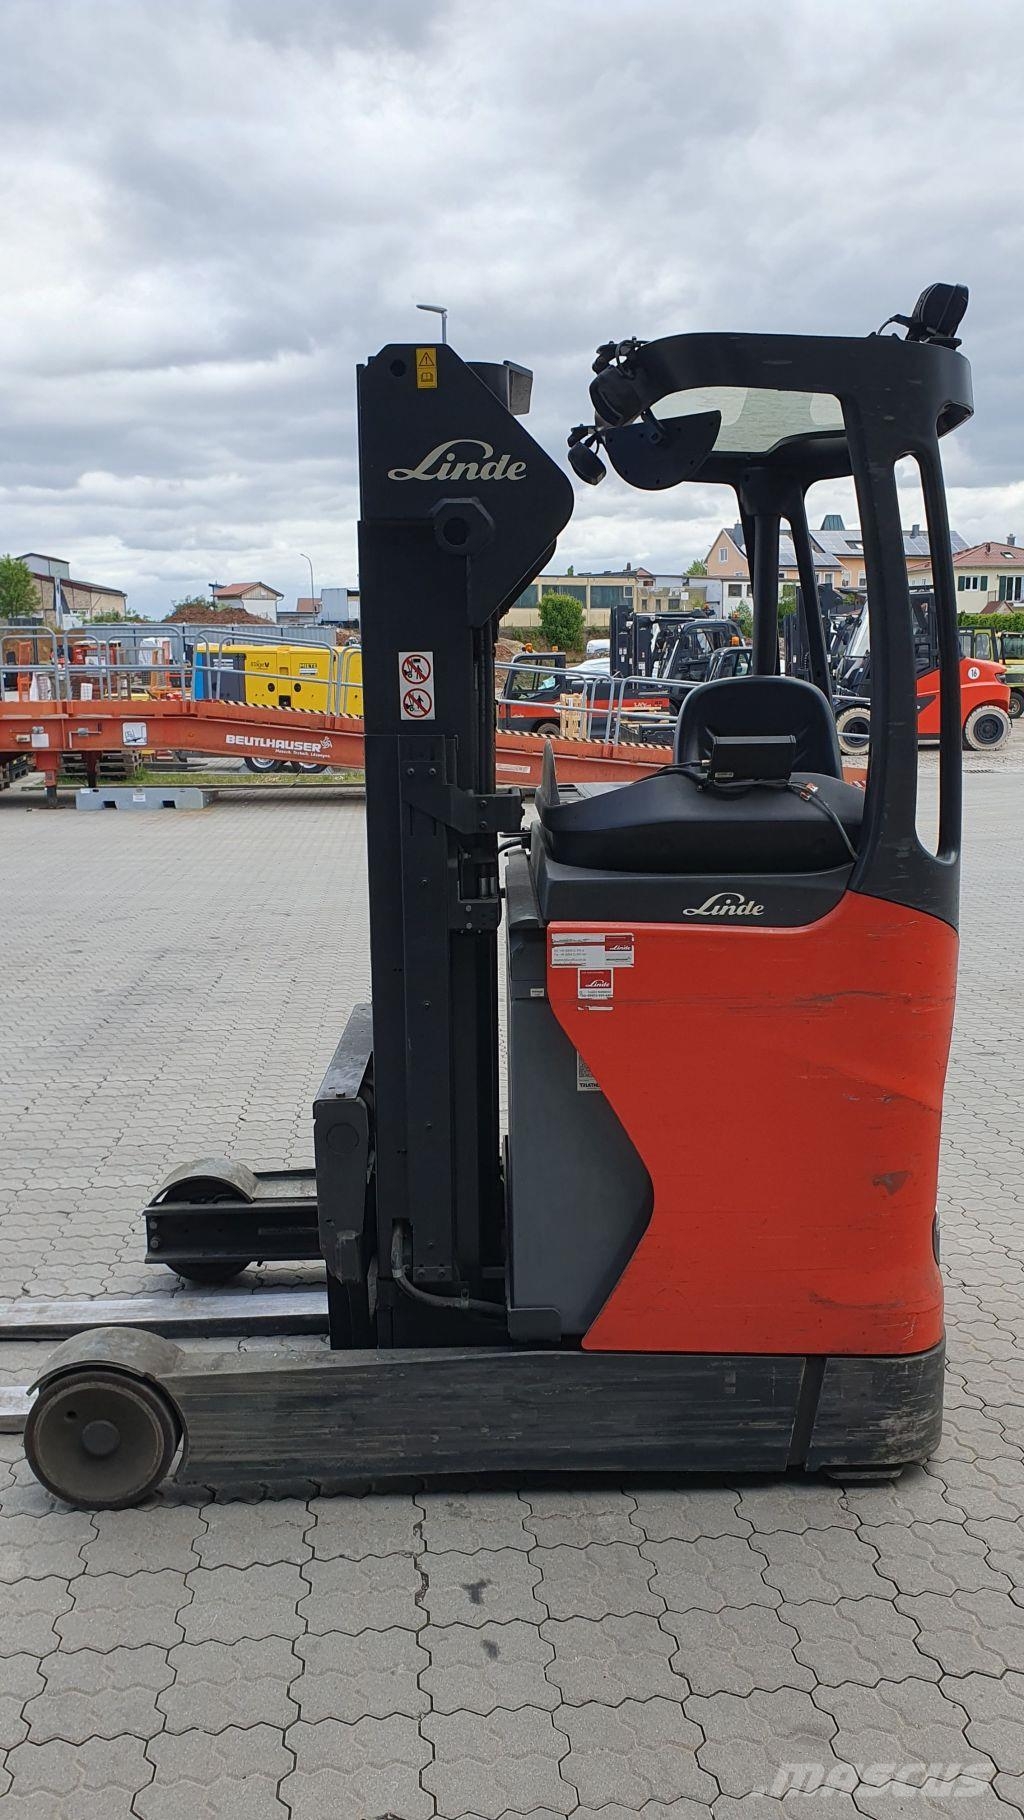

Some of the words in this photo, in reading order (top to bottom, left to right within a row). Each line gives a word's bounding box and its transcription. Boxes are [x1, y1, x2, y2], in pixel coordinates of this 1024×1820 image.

[387, 439, 527, 480] Linde
[971, 669, 978, 678] 16
[225, 734, 322, 753] BEUTLHAUSER
[682, 892, 765, 916] Linde
[585, 979, 611, 987] Linde
